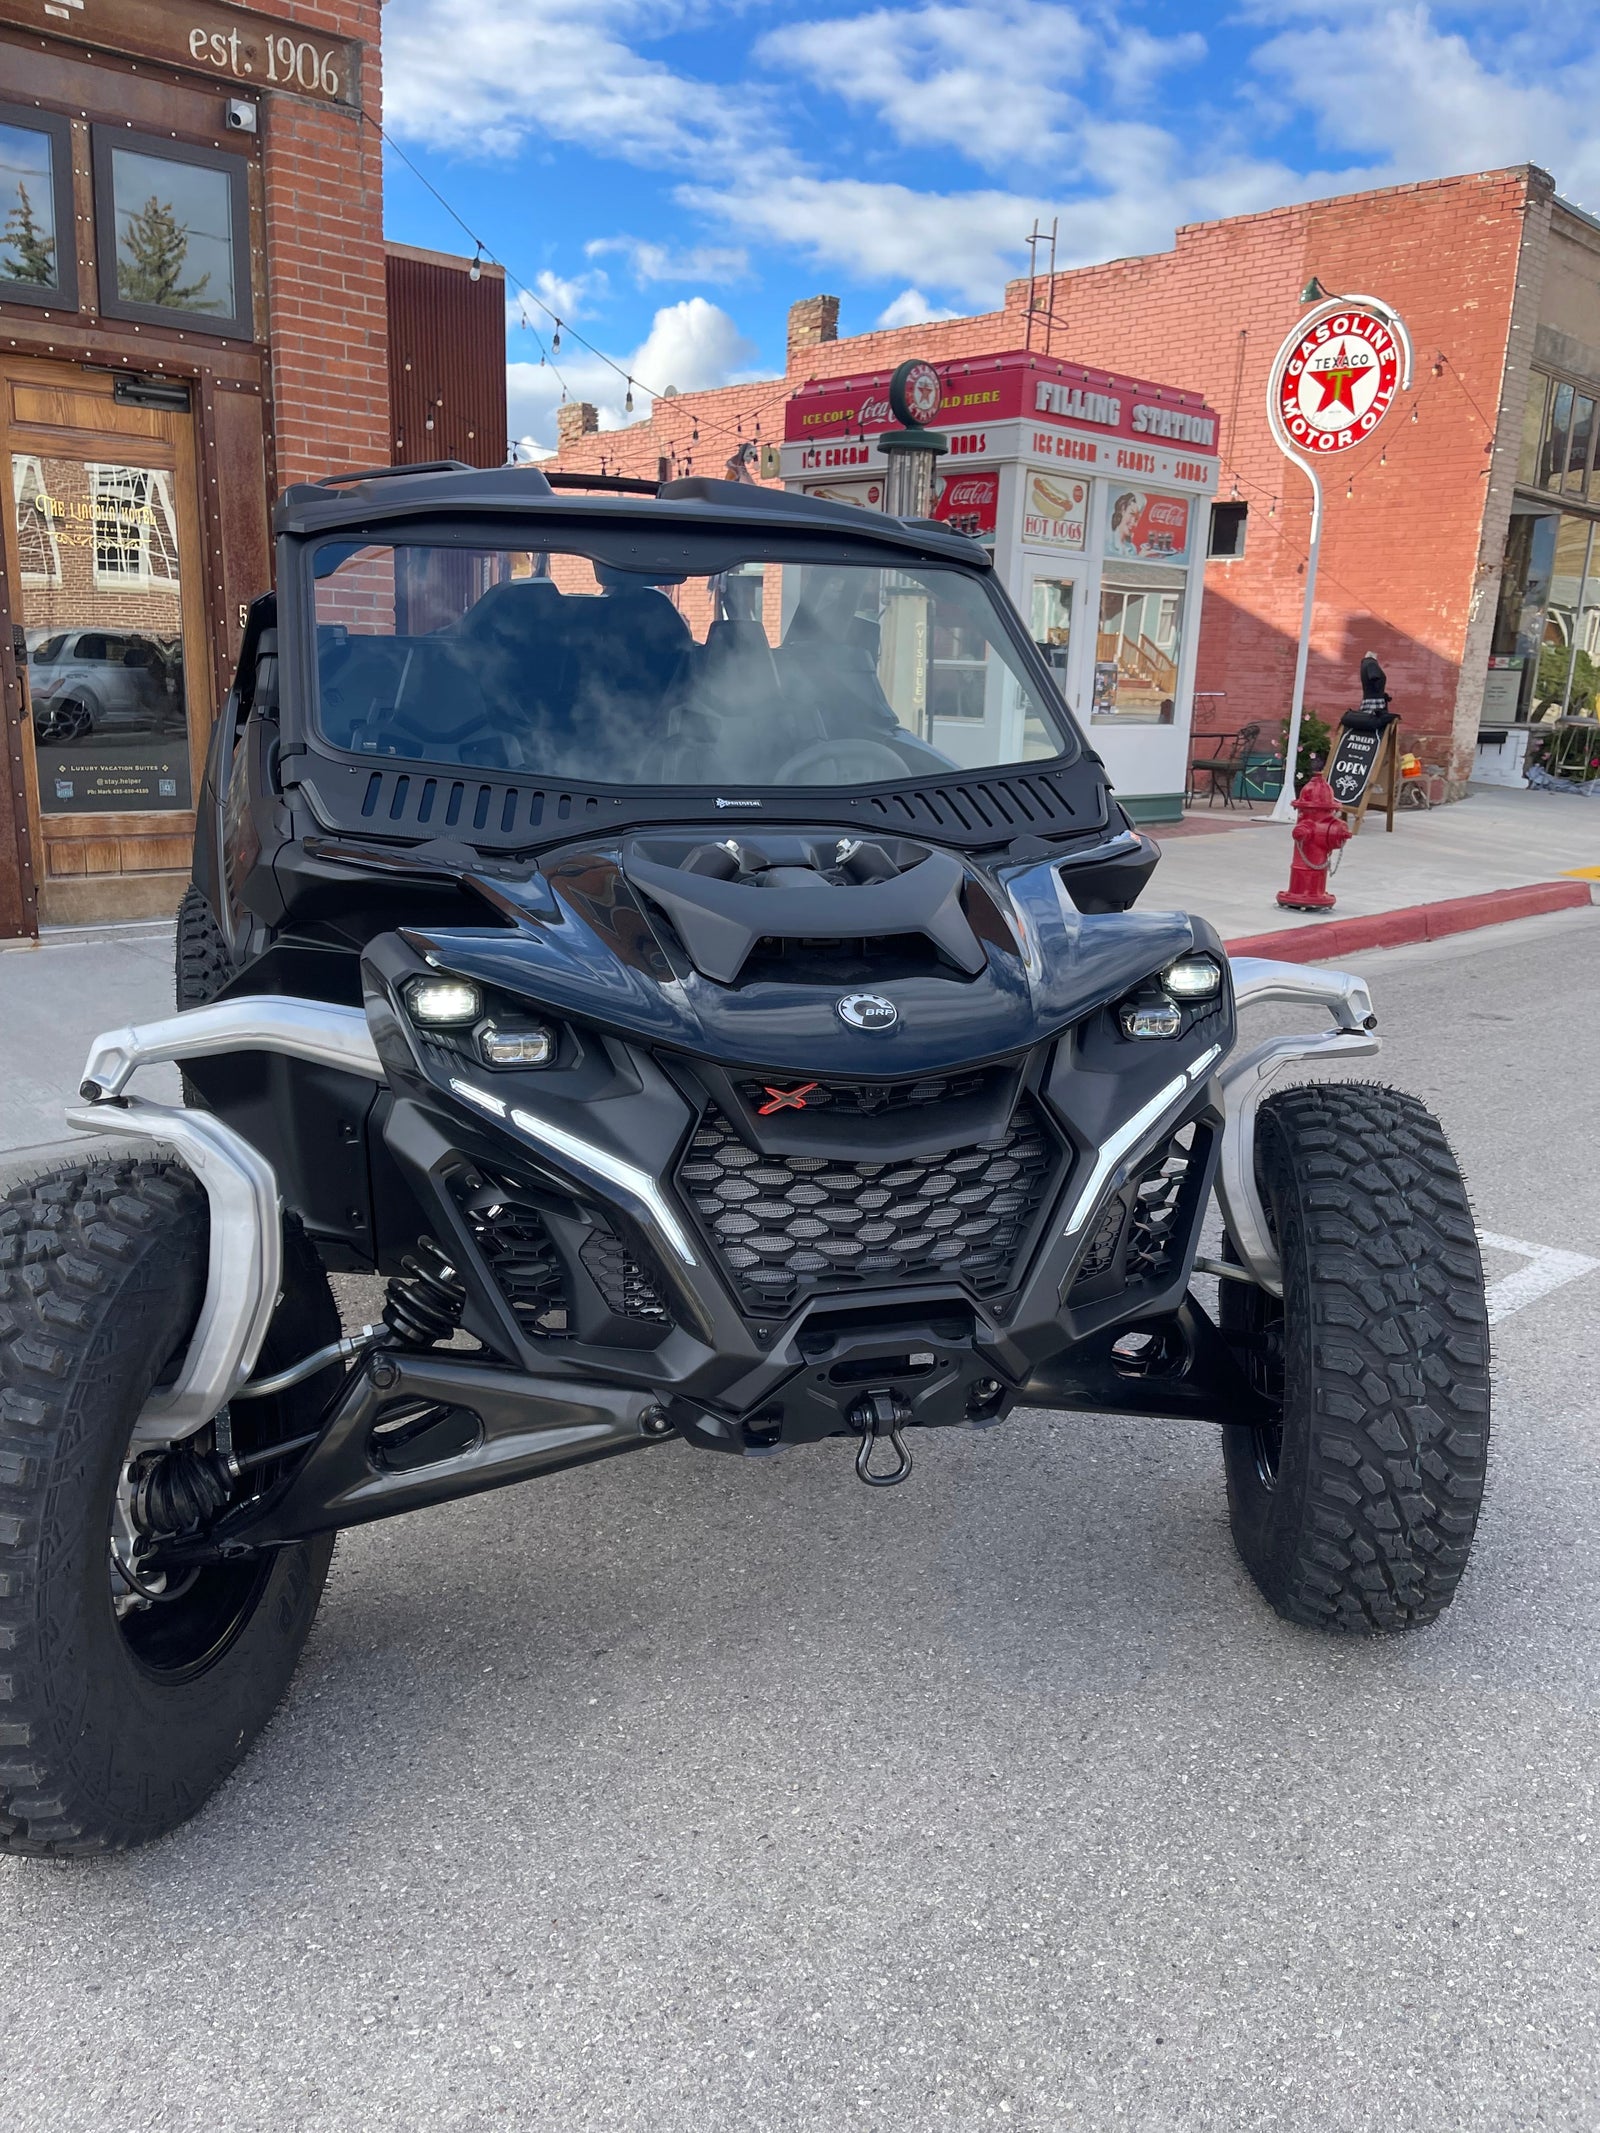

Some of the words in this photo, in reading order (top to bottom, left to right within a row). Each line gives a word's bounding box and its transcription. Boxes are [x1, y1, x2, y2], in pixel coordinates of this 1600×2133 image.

[189, 27, 252, 77] est.
[265, 33, 339, 96] 1906
[1288, 317, 1395, 376] GASOLINE
[1315, 353, 1369, 370] TEXACO
[1327, 370, 1352, 400] T
[803, 411, 821, 425] ICE
[823, 409, 854, 423] COLD
[963, 390, 1001, 406] HERE
[1035, 381, 1121, 426] FILLING
[1132, 404, 1215, 446] STATION
[1283, 397, 1353, 449] MOTOR
[1361, 386, 1393, 430] OIL
[825, 446, 869, 466] CREAM
[1033, 433, 1053, 453] ICE
[1056, 438, 1097, 463] CREAM
[1117, 449, 1155, 473] FLOATS
[1174, 461, 1208, 483] SODAS
[35, 495, 65, 517] THE
[70, 502, 116, 522] LINCOLN
[121, 506, 157, 526] HOTEL
[1025, 516, 1047, 536] HOT
[1053, 519, 1082, 540] DOGS
[915, 629, 924, 696] VISIBLE
[1336, 760, 1367, 776] OPEN
[865, 1008, 894, 1016] BRP
